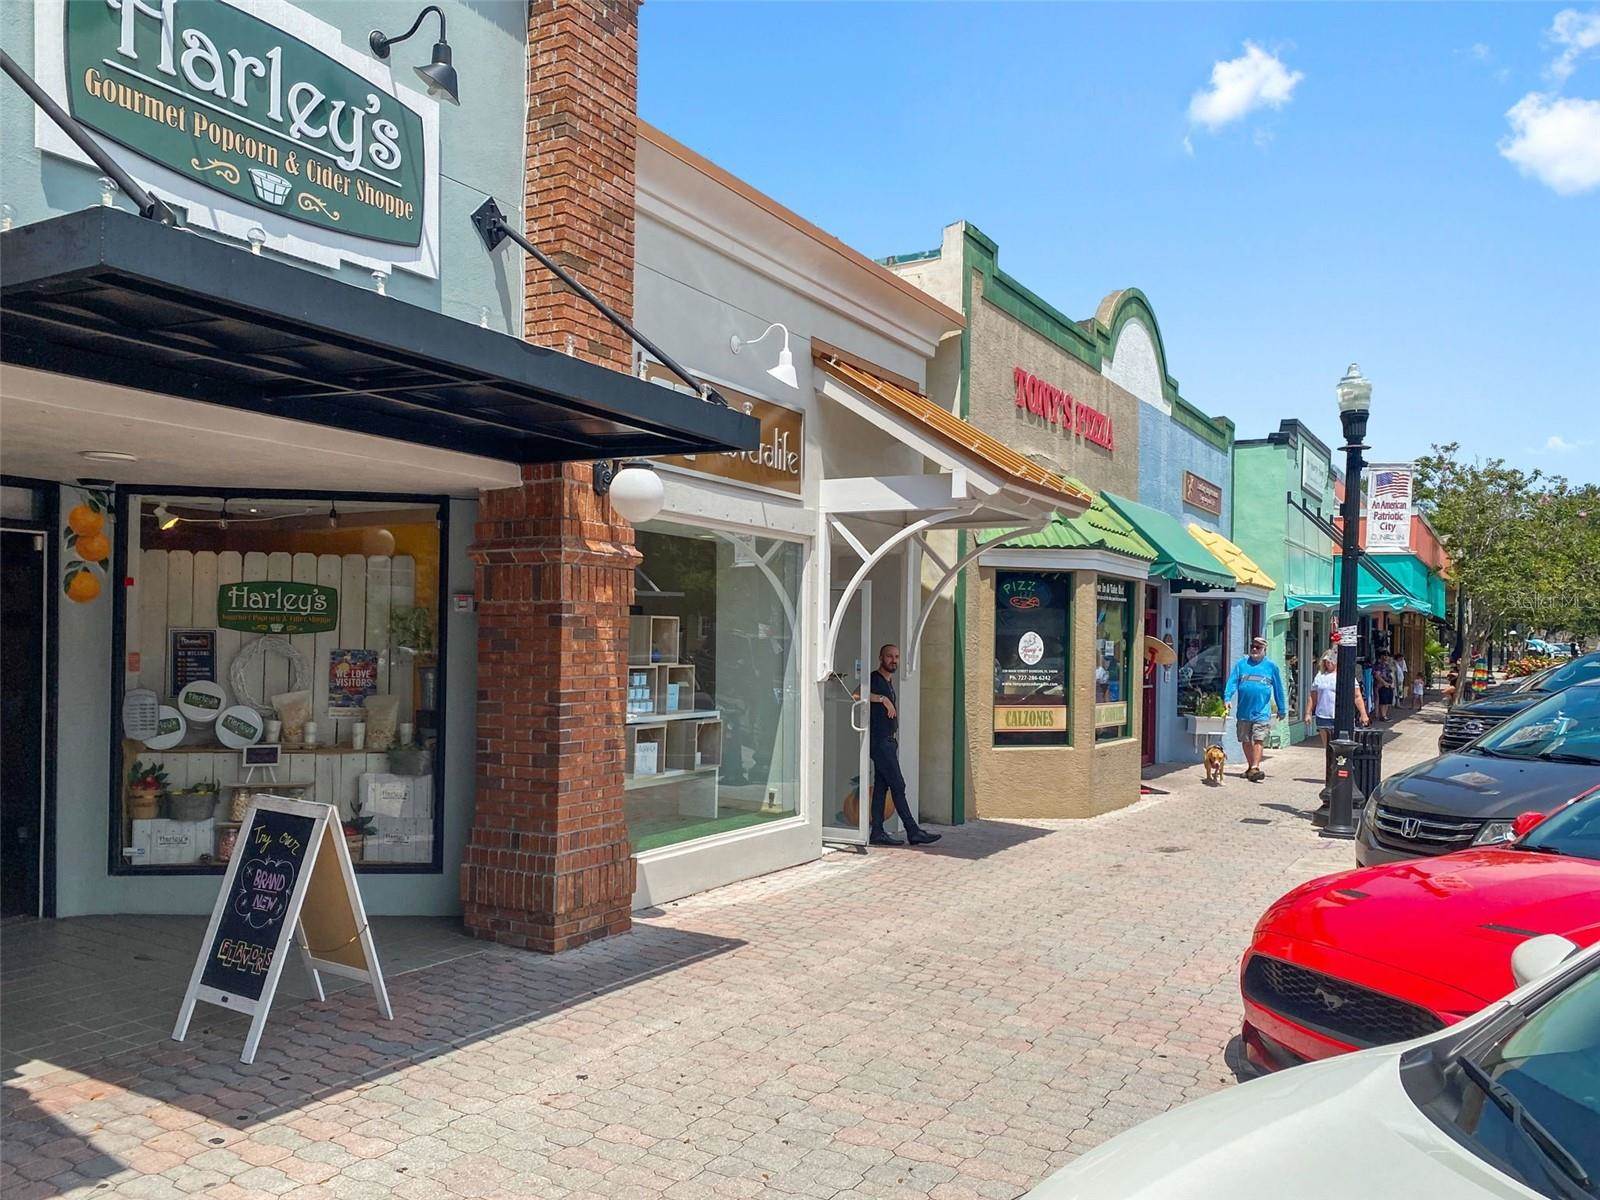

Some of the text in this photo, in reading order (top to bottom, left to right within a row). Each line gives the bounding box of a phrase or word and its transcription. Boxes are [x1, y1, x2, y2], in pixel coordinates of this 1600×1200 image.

[106, 0, 402, 171] Harley's
[84, 67, 414, 221] Gourmet Popcorn & Cider Shoppe
[1013, 366, 1114, 452] TONY'S PIZZA
[1371, 500, 1407, 509] An American
[1373, 511, 1404, 520] Patriotic
[1380, 522, 1396, 532] City
[228, 586, 328, 615] Harley's
[335, 670, 371, 678] WE LOVE
[335, 679, 372, 687] VISITORS
[1005, 710, 1055, 727] CALZONES
[254, 825, 272, 853] Try
[253, 869, 285, 891] BRAND
[252, 894, 278, 911] NEW
